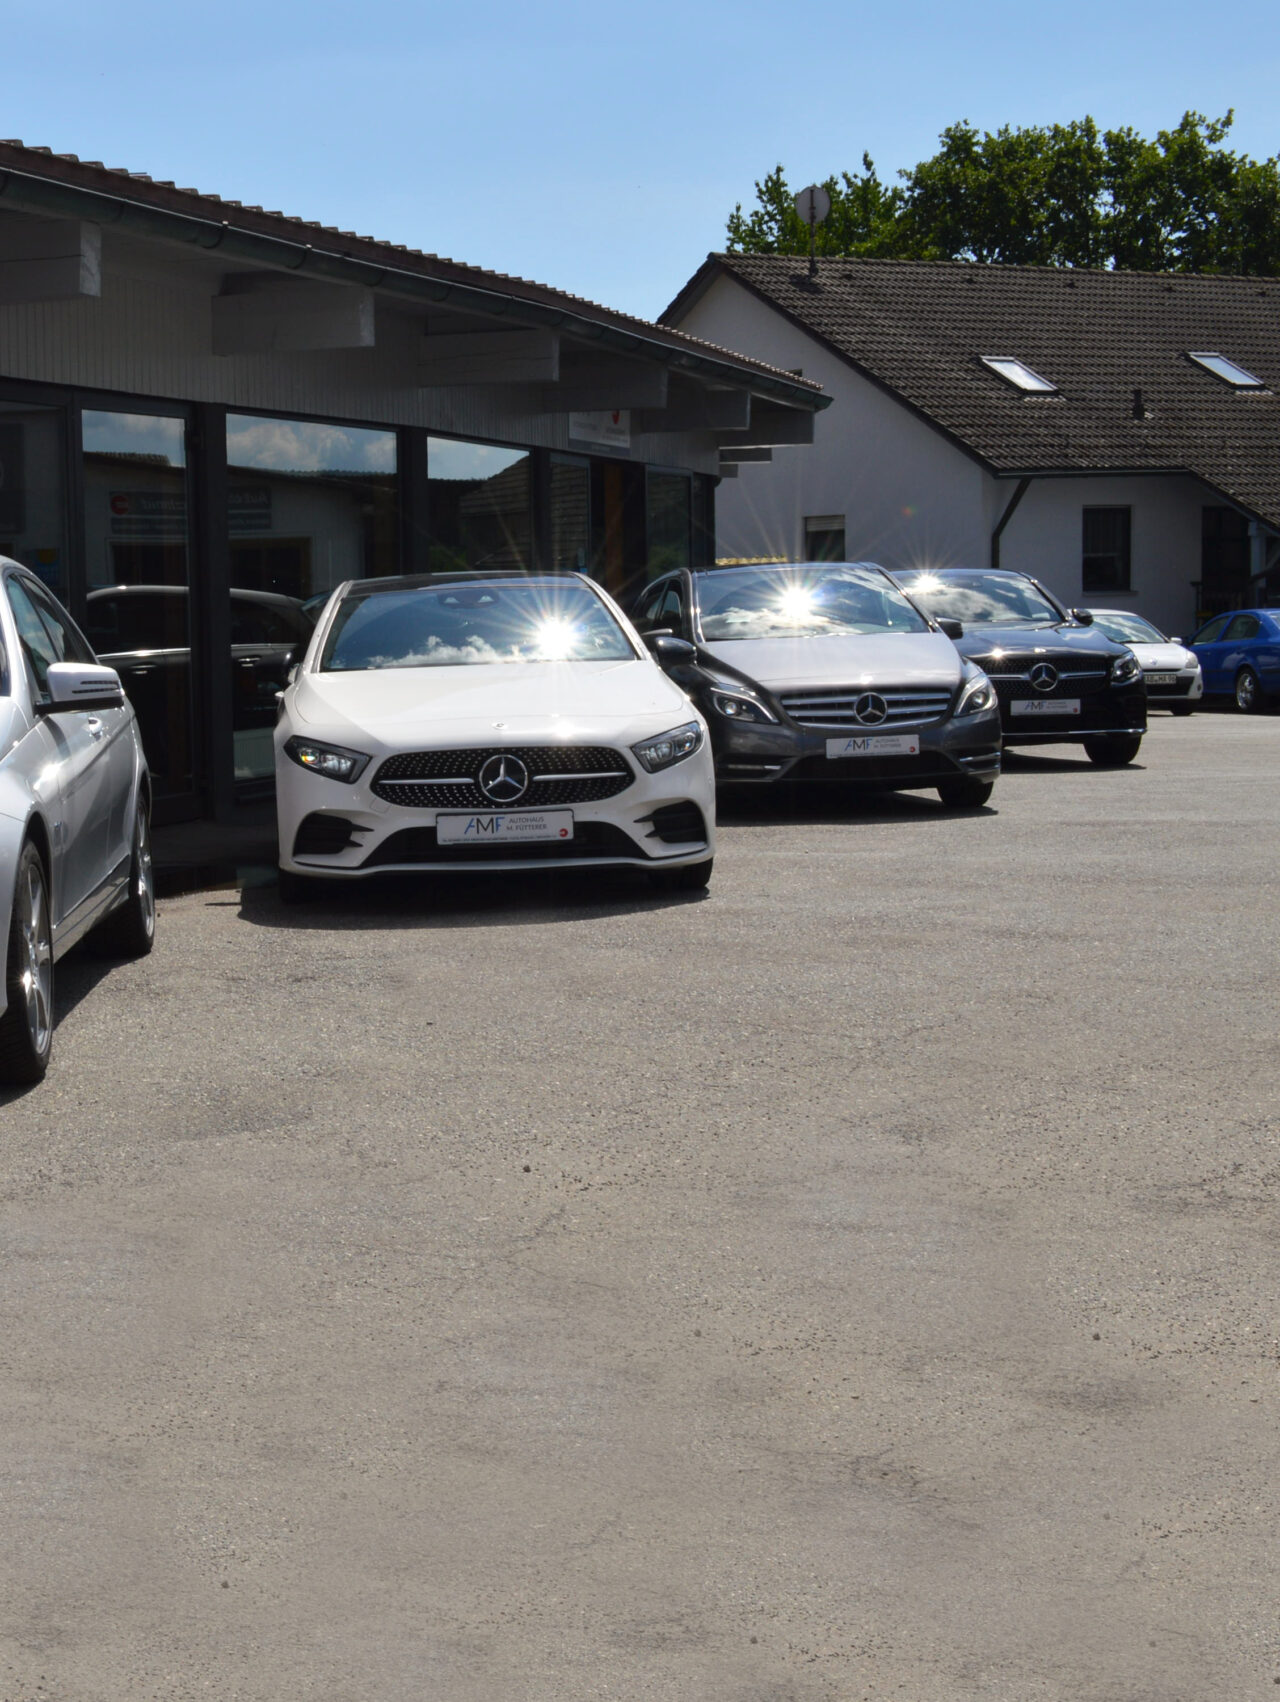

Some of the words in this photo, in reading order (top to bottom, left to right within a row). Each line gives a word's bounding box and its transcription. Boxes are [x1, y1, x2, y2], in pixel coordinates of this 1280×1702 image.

[844, 738, 872, 751] AMF
[464, 816, 505, 834] AMF
[509, 816, 544, 824] AUTOHAUS
